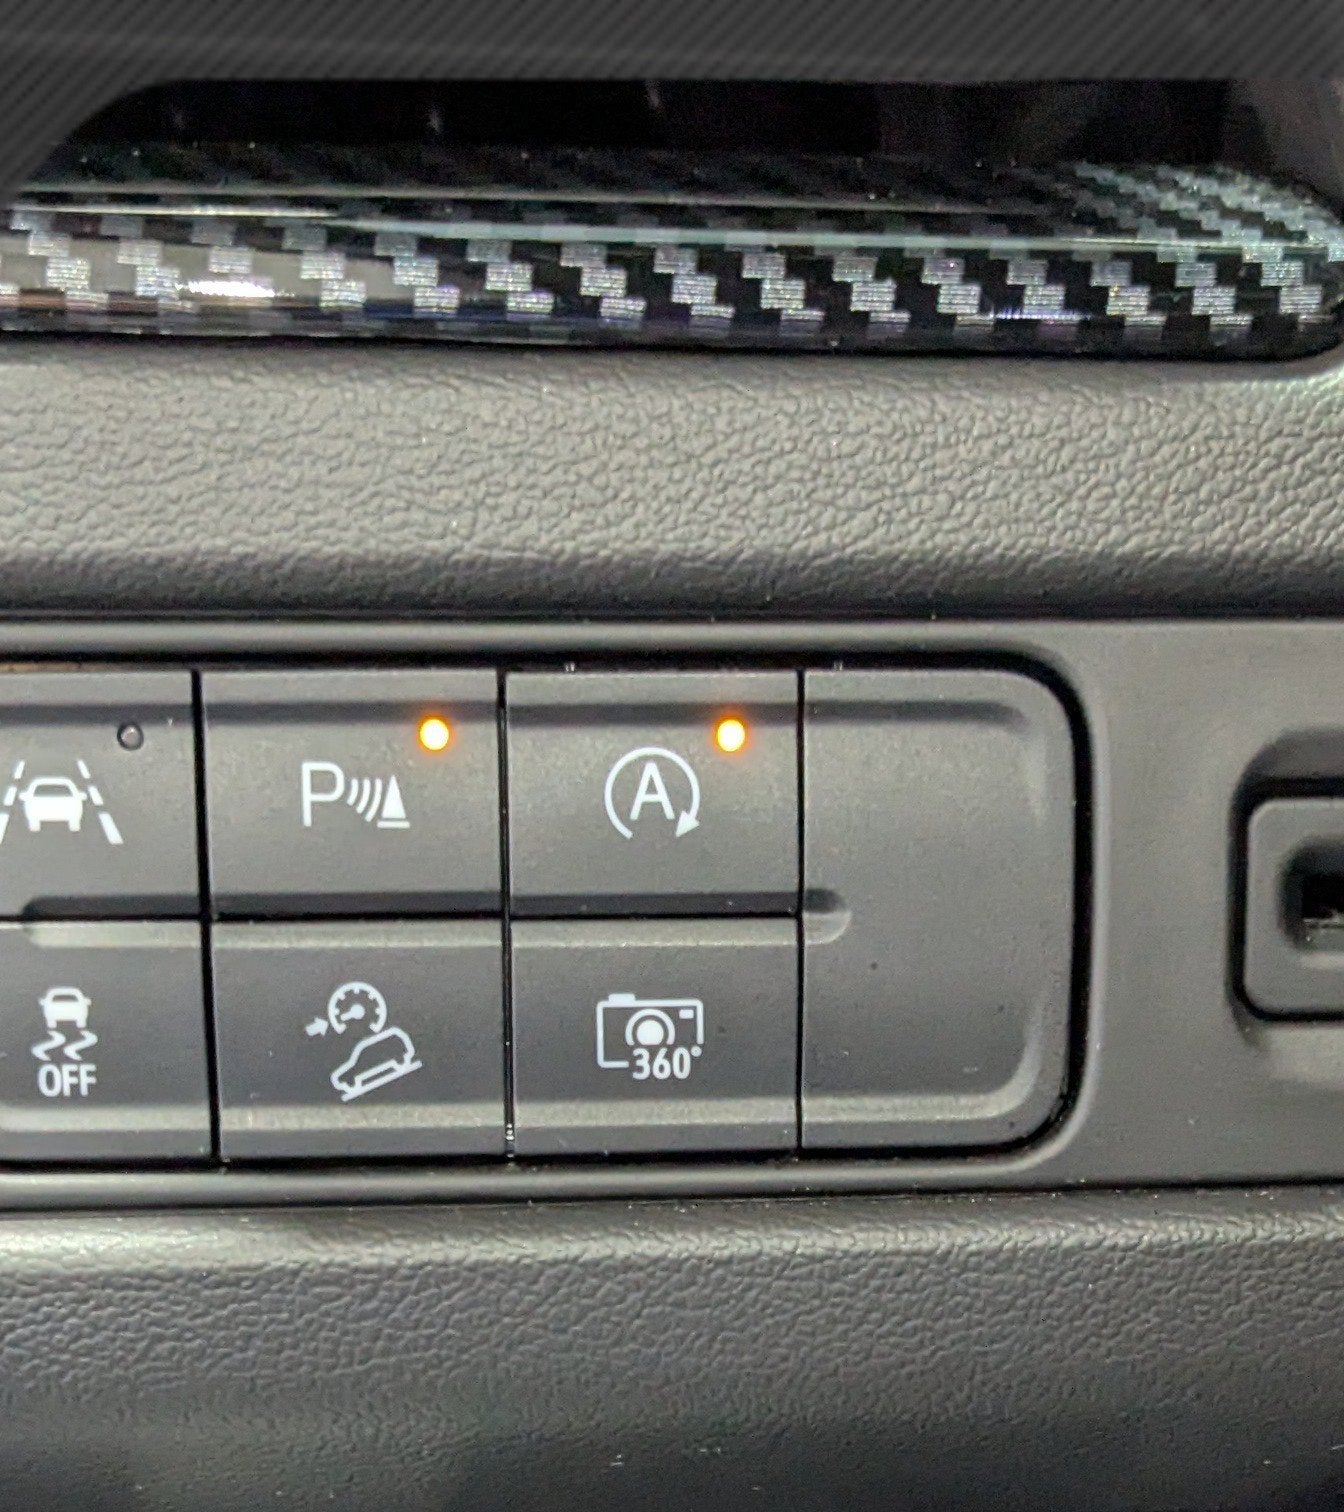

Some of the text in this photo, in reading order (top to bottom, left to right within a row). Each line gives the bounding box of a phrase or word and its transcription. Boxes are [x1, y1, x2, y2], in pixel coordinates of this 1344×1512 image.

[300, 760, 345, 828] P
[629, 760, 675, 821] A
[37, 1062, 97, 1097] OFF
